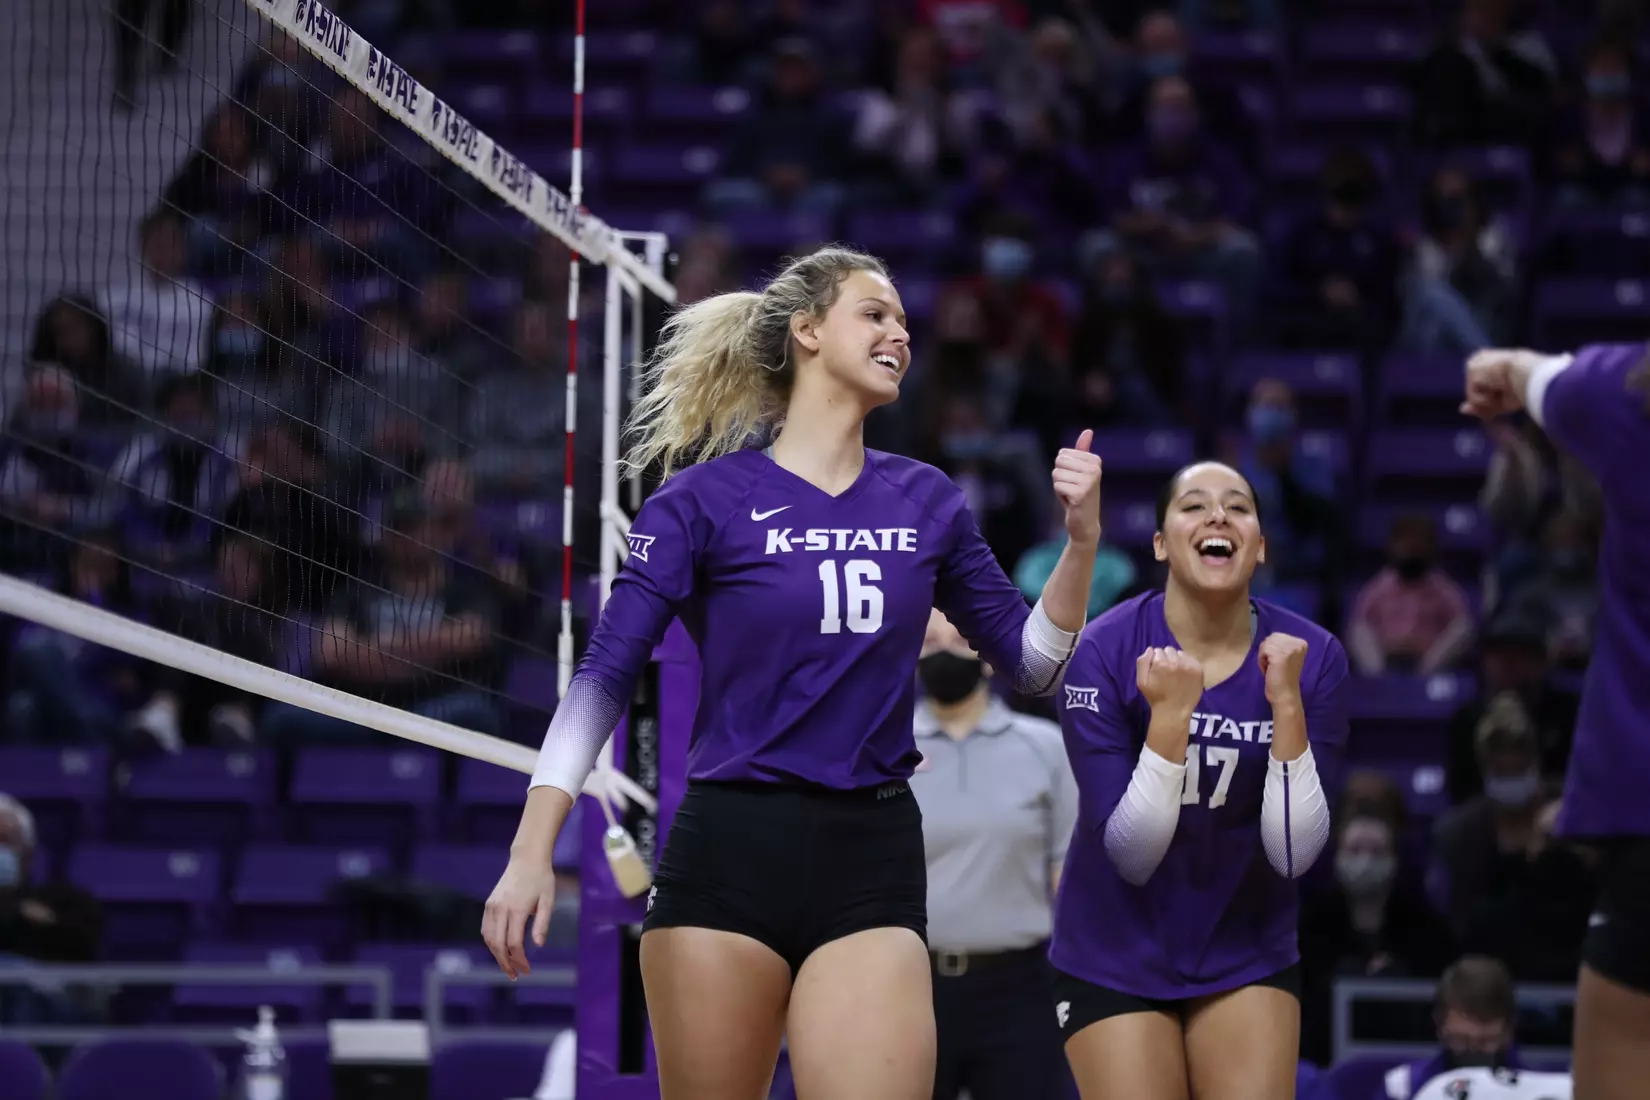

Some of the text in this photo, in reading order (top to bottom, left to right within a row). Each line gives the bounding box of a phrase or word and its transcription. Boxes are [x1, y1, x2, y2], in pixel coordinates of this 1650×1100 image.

[765, 528, 917, 555] K-STATE
[818, 559, 884, 634] 16
[1189, 712, 1274, 743] STATE
[1181, 744, 1240, 809] 17
